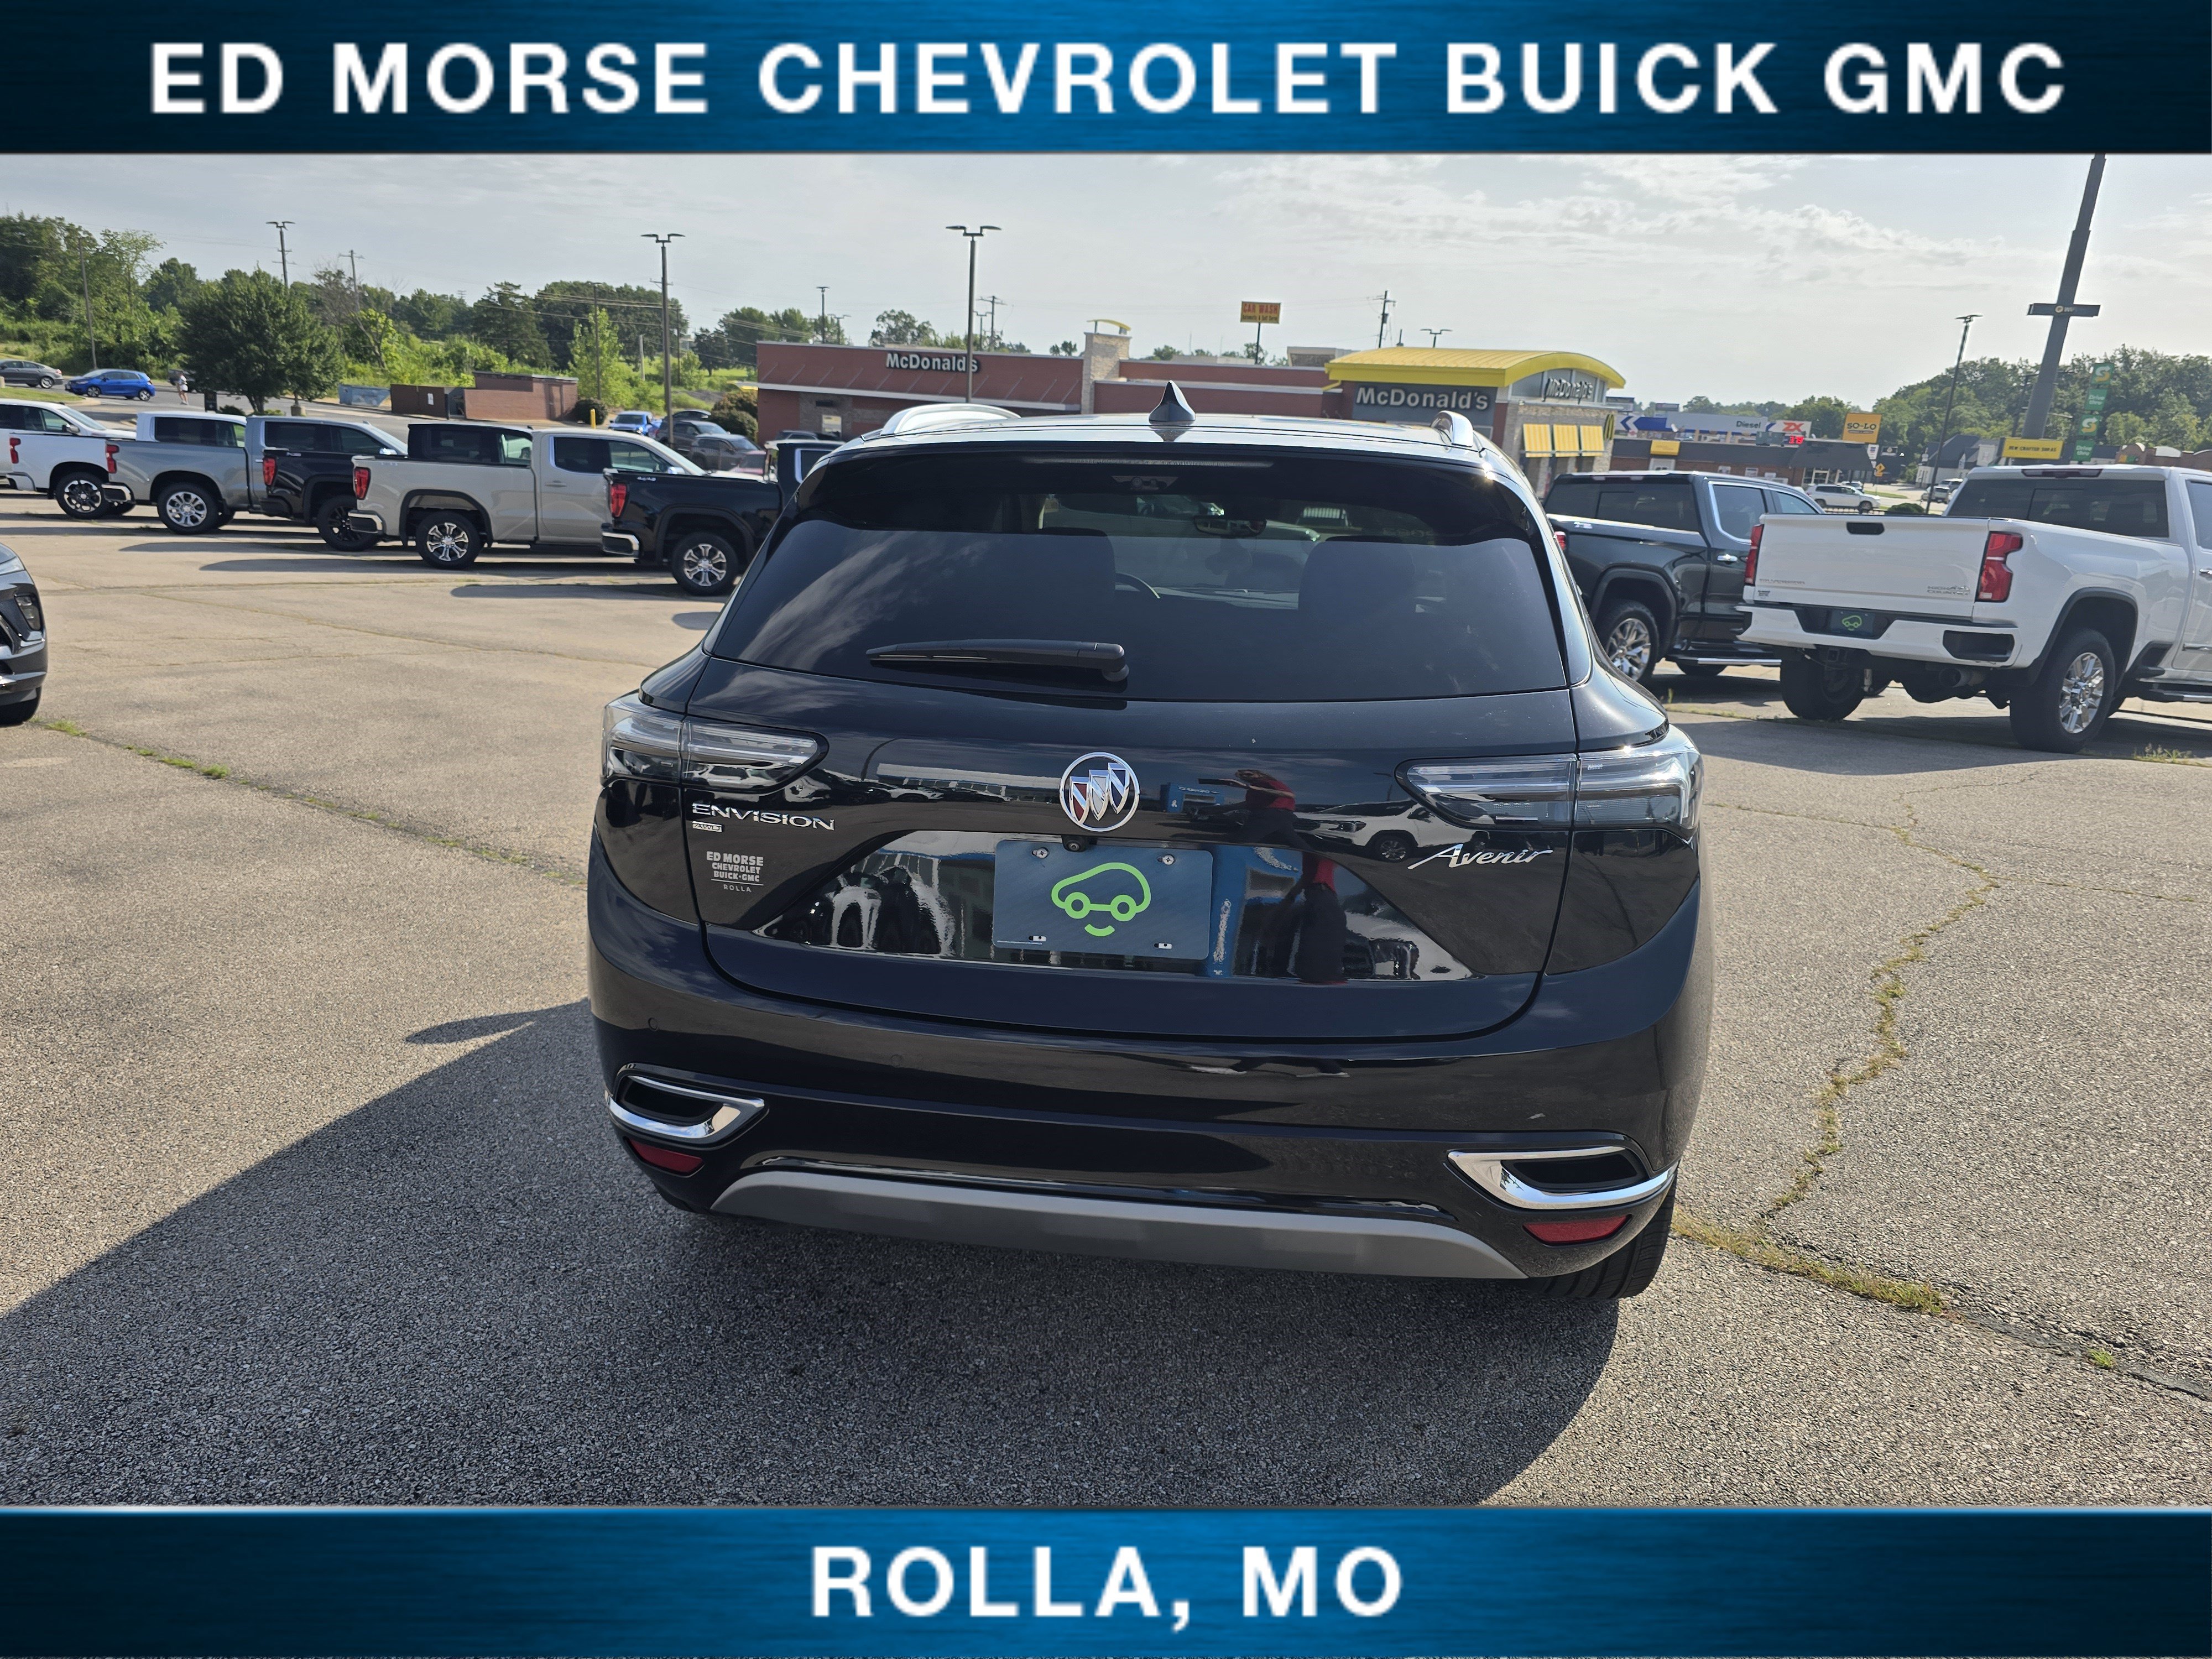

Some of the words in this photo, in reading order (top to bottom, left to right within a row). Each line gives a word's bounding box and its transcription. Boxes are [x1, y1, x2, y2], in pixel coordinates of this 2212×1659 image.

[885, 352, 979, 373] McDonalds
[1356, 387, 1489, 410] McDonald's
[1736, 420, 1761, 429] Diesel
[1782, 421, 1805, 432] ZX
[1846, 422, 1877, 430] SO-LO
[692, 802, 835, 831] ENVISION
[693, 822, 722, 832] AWD
[706, 851, 721, 862] ED
[723, 852, 764, 867] MORSE
[1407, 843, 1553, 869] Avenir
[712, 862, 761, 875] CHEVROLET
[723, 884, 752, 893] ROLLA
